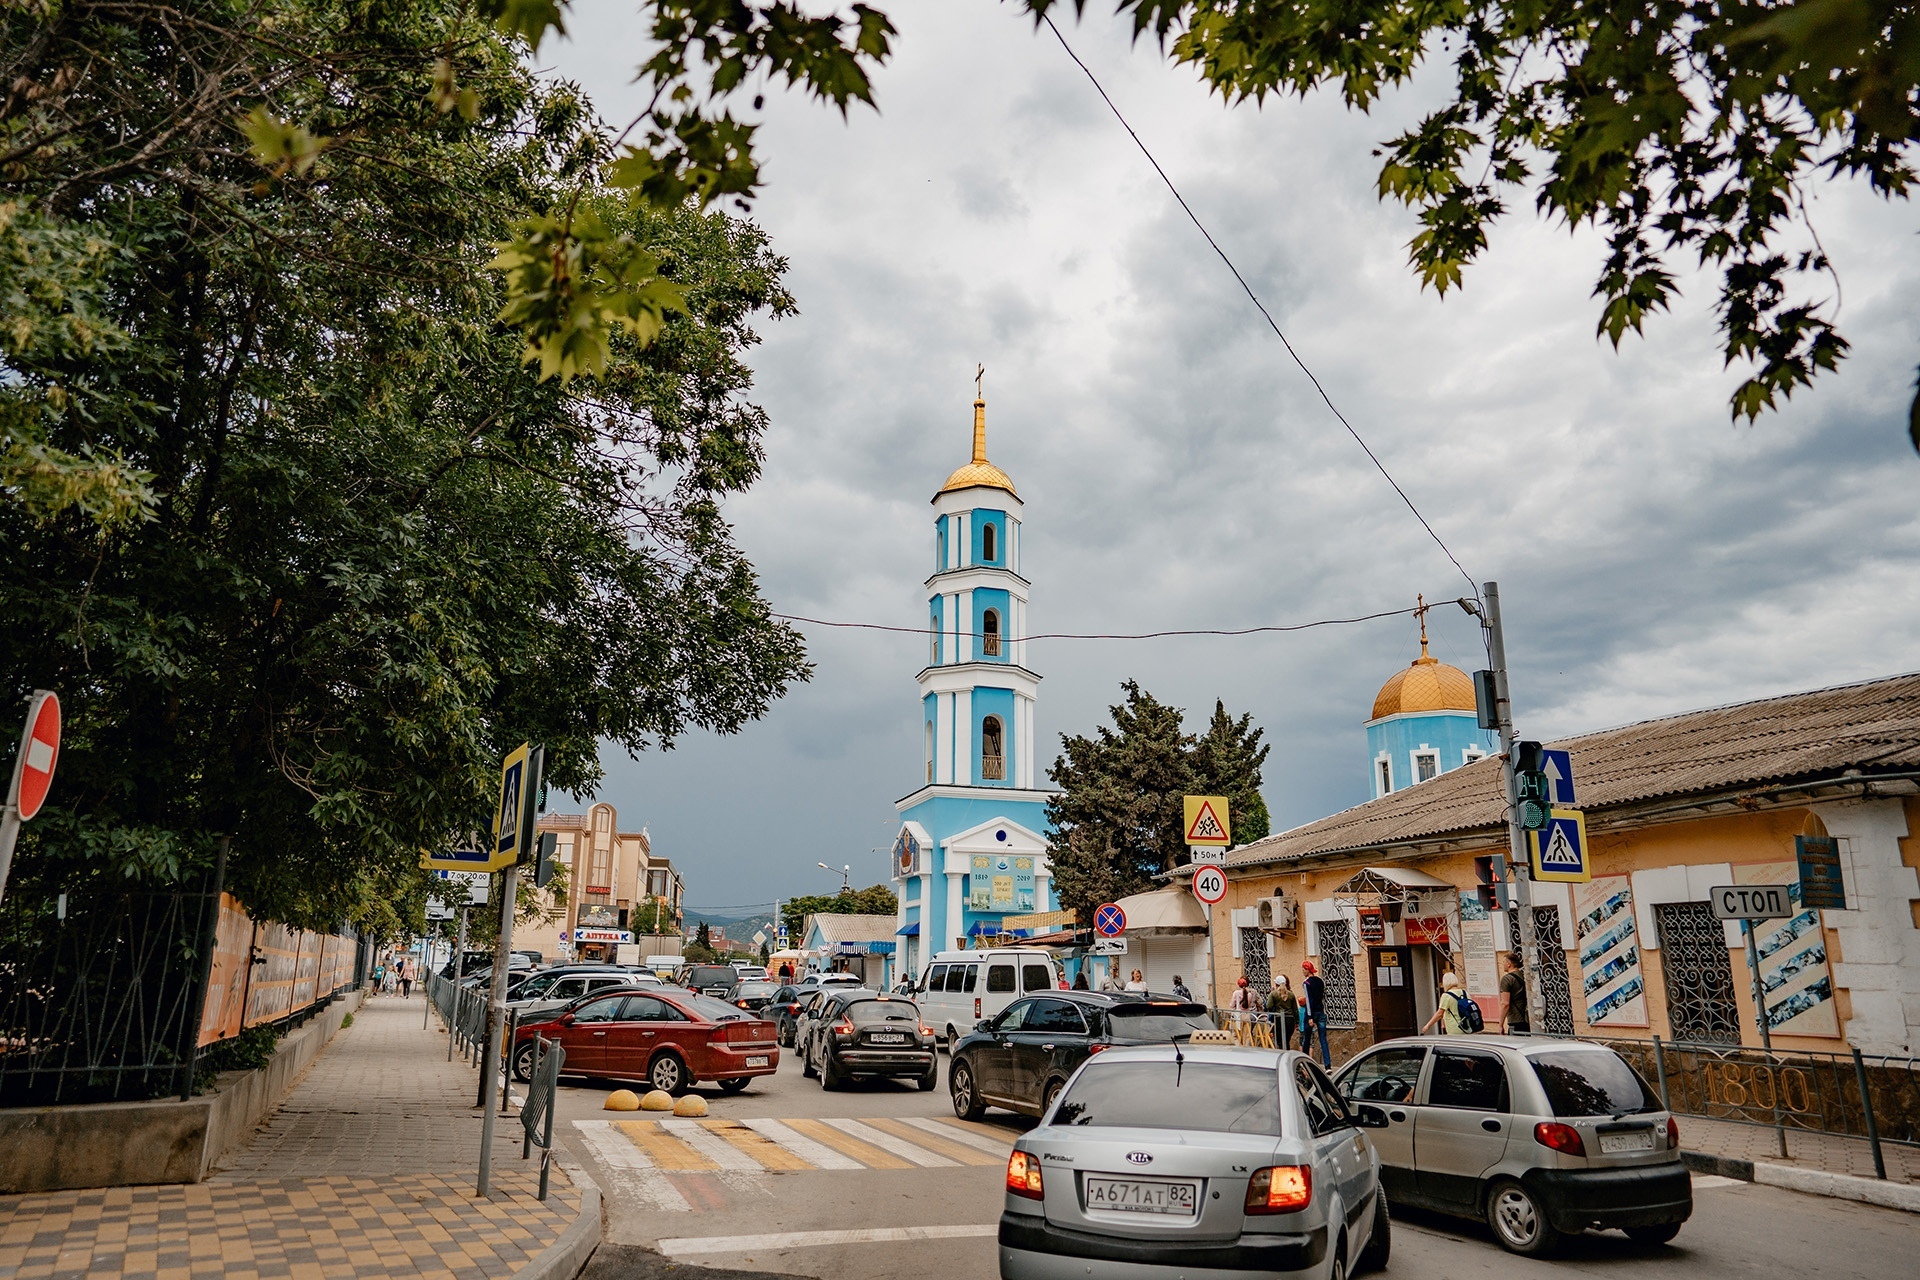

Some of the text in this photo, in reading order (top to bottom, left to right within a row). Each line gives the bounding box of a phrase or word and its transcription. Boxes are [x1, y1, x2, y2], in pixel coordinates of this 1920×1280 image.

[1200, 877, 1220, 892] 40
[1722, 890, 1782, 913] СТОП
[585, 932, 619, 940] АПТЕКА
[1705, 1062, 1810, 1113] 1800
[1130, 1153, 1150, 1163] KIA
[1095, 1184, 1187, 1204] А671АТ 82
